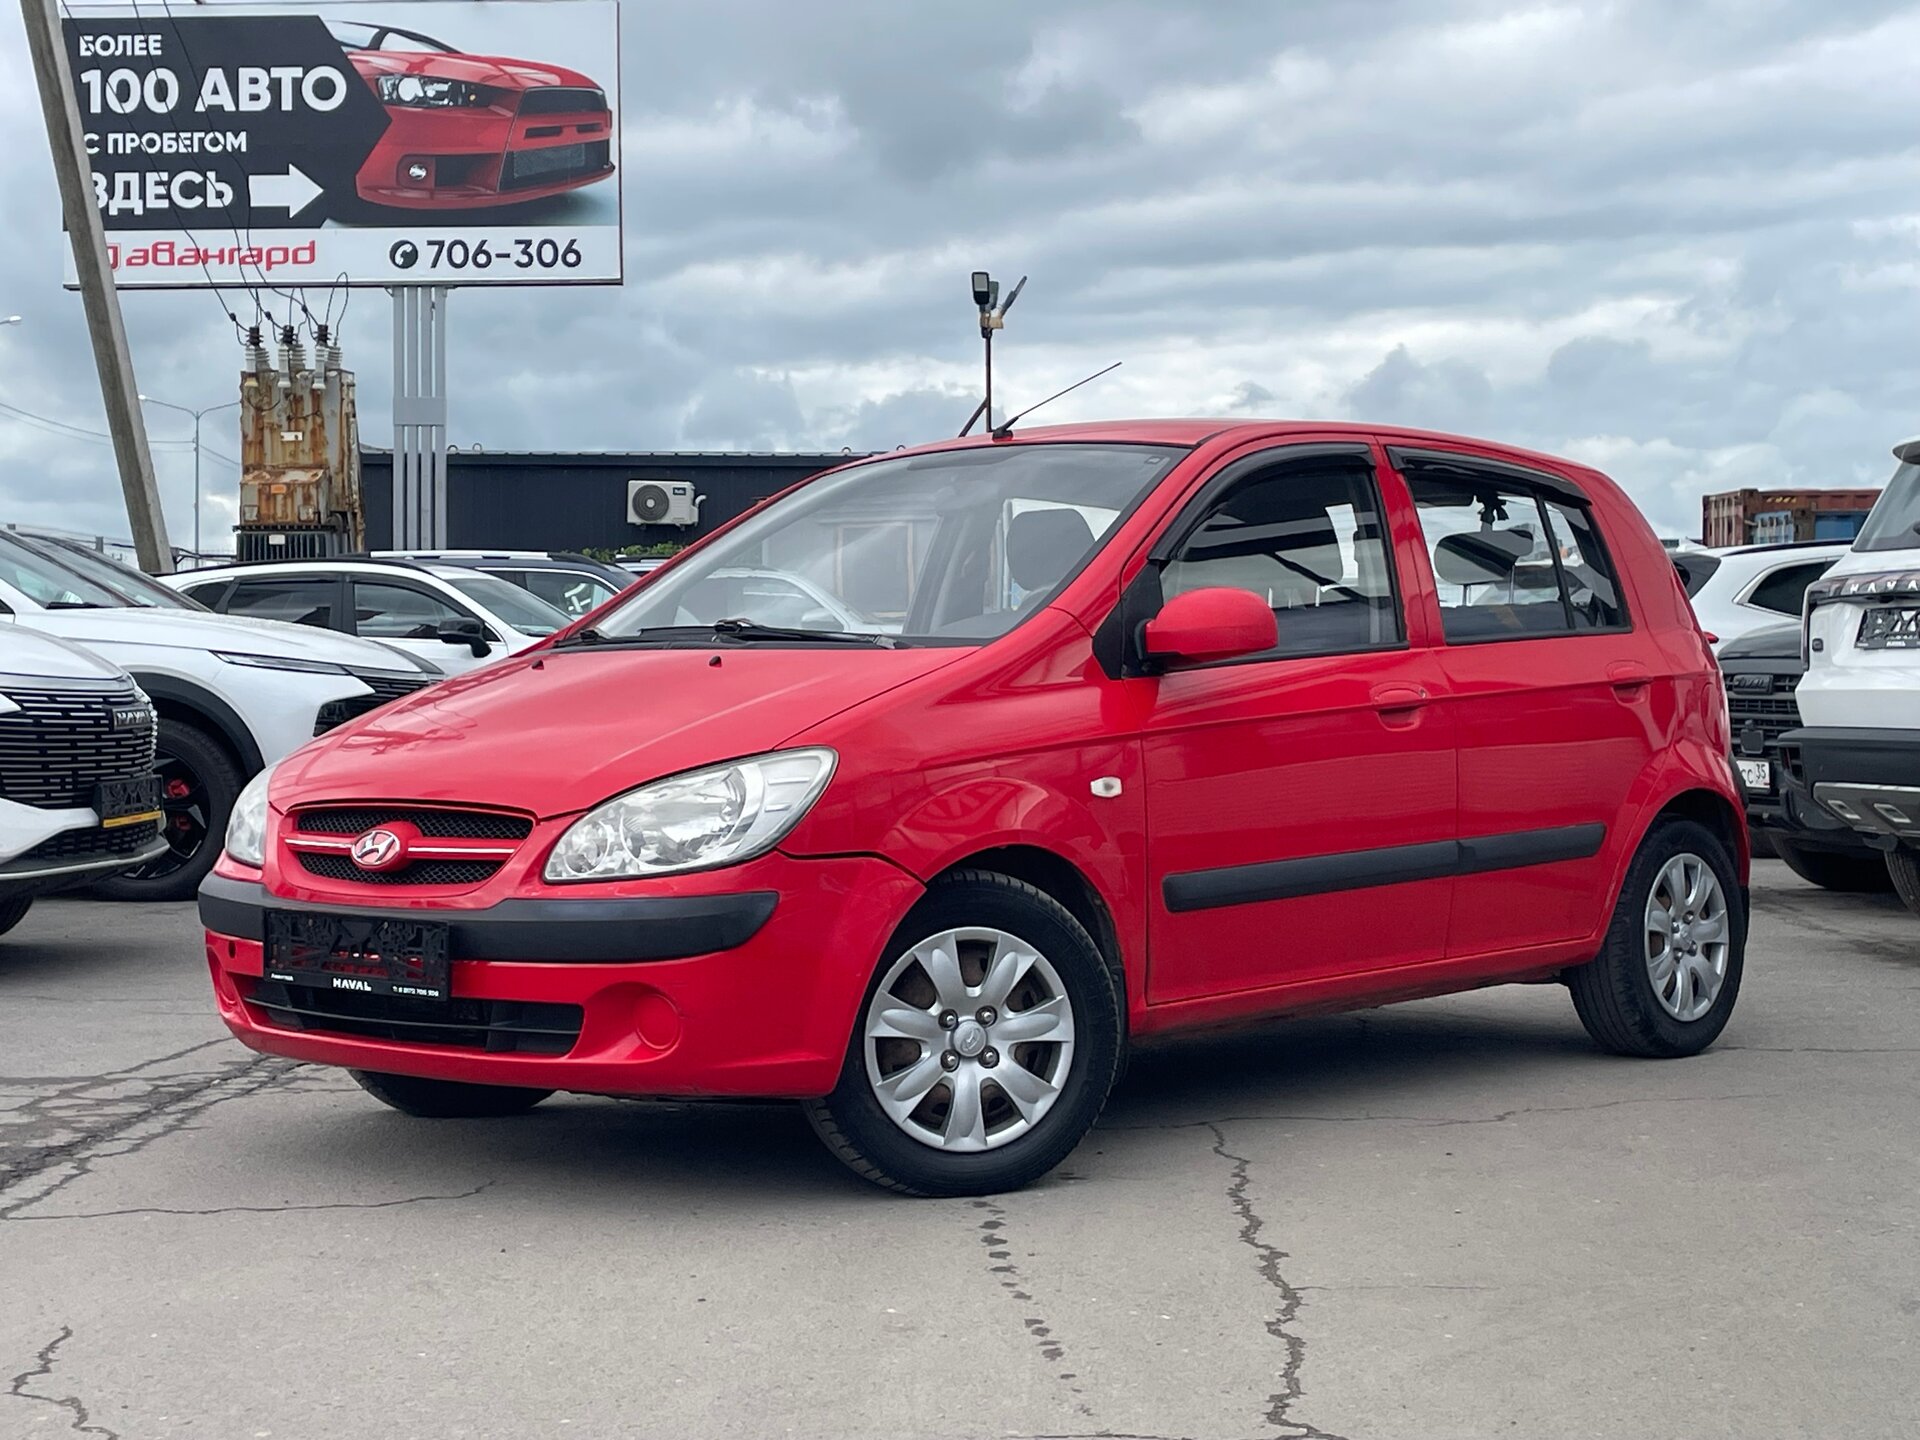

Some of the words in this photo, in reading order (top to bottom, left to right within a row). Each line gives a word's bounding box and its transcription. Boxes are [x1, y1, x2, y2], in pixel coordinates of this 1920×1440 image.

[79, 34, 162, 57] БОЛЕЕ
[80, 67, 179, 114] 100
[194, 65, 347, 112] АВТО
[84, 132, 100, 155] С
[107, 131, 247, 155] ПРОБЕГОМ
[426, 238, 582, 269] 706-306
[1755, 763, 1767, 780] 35
[332, 977, 373, 992] HAVAL
